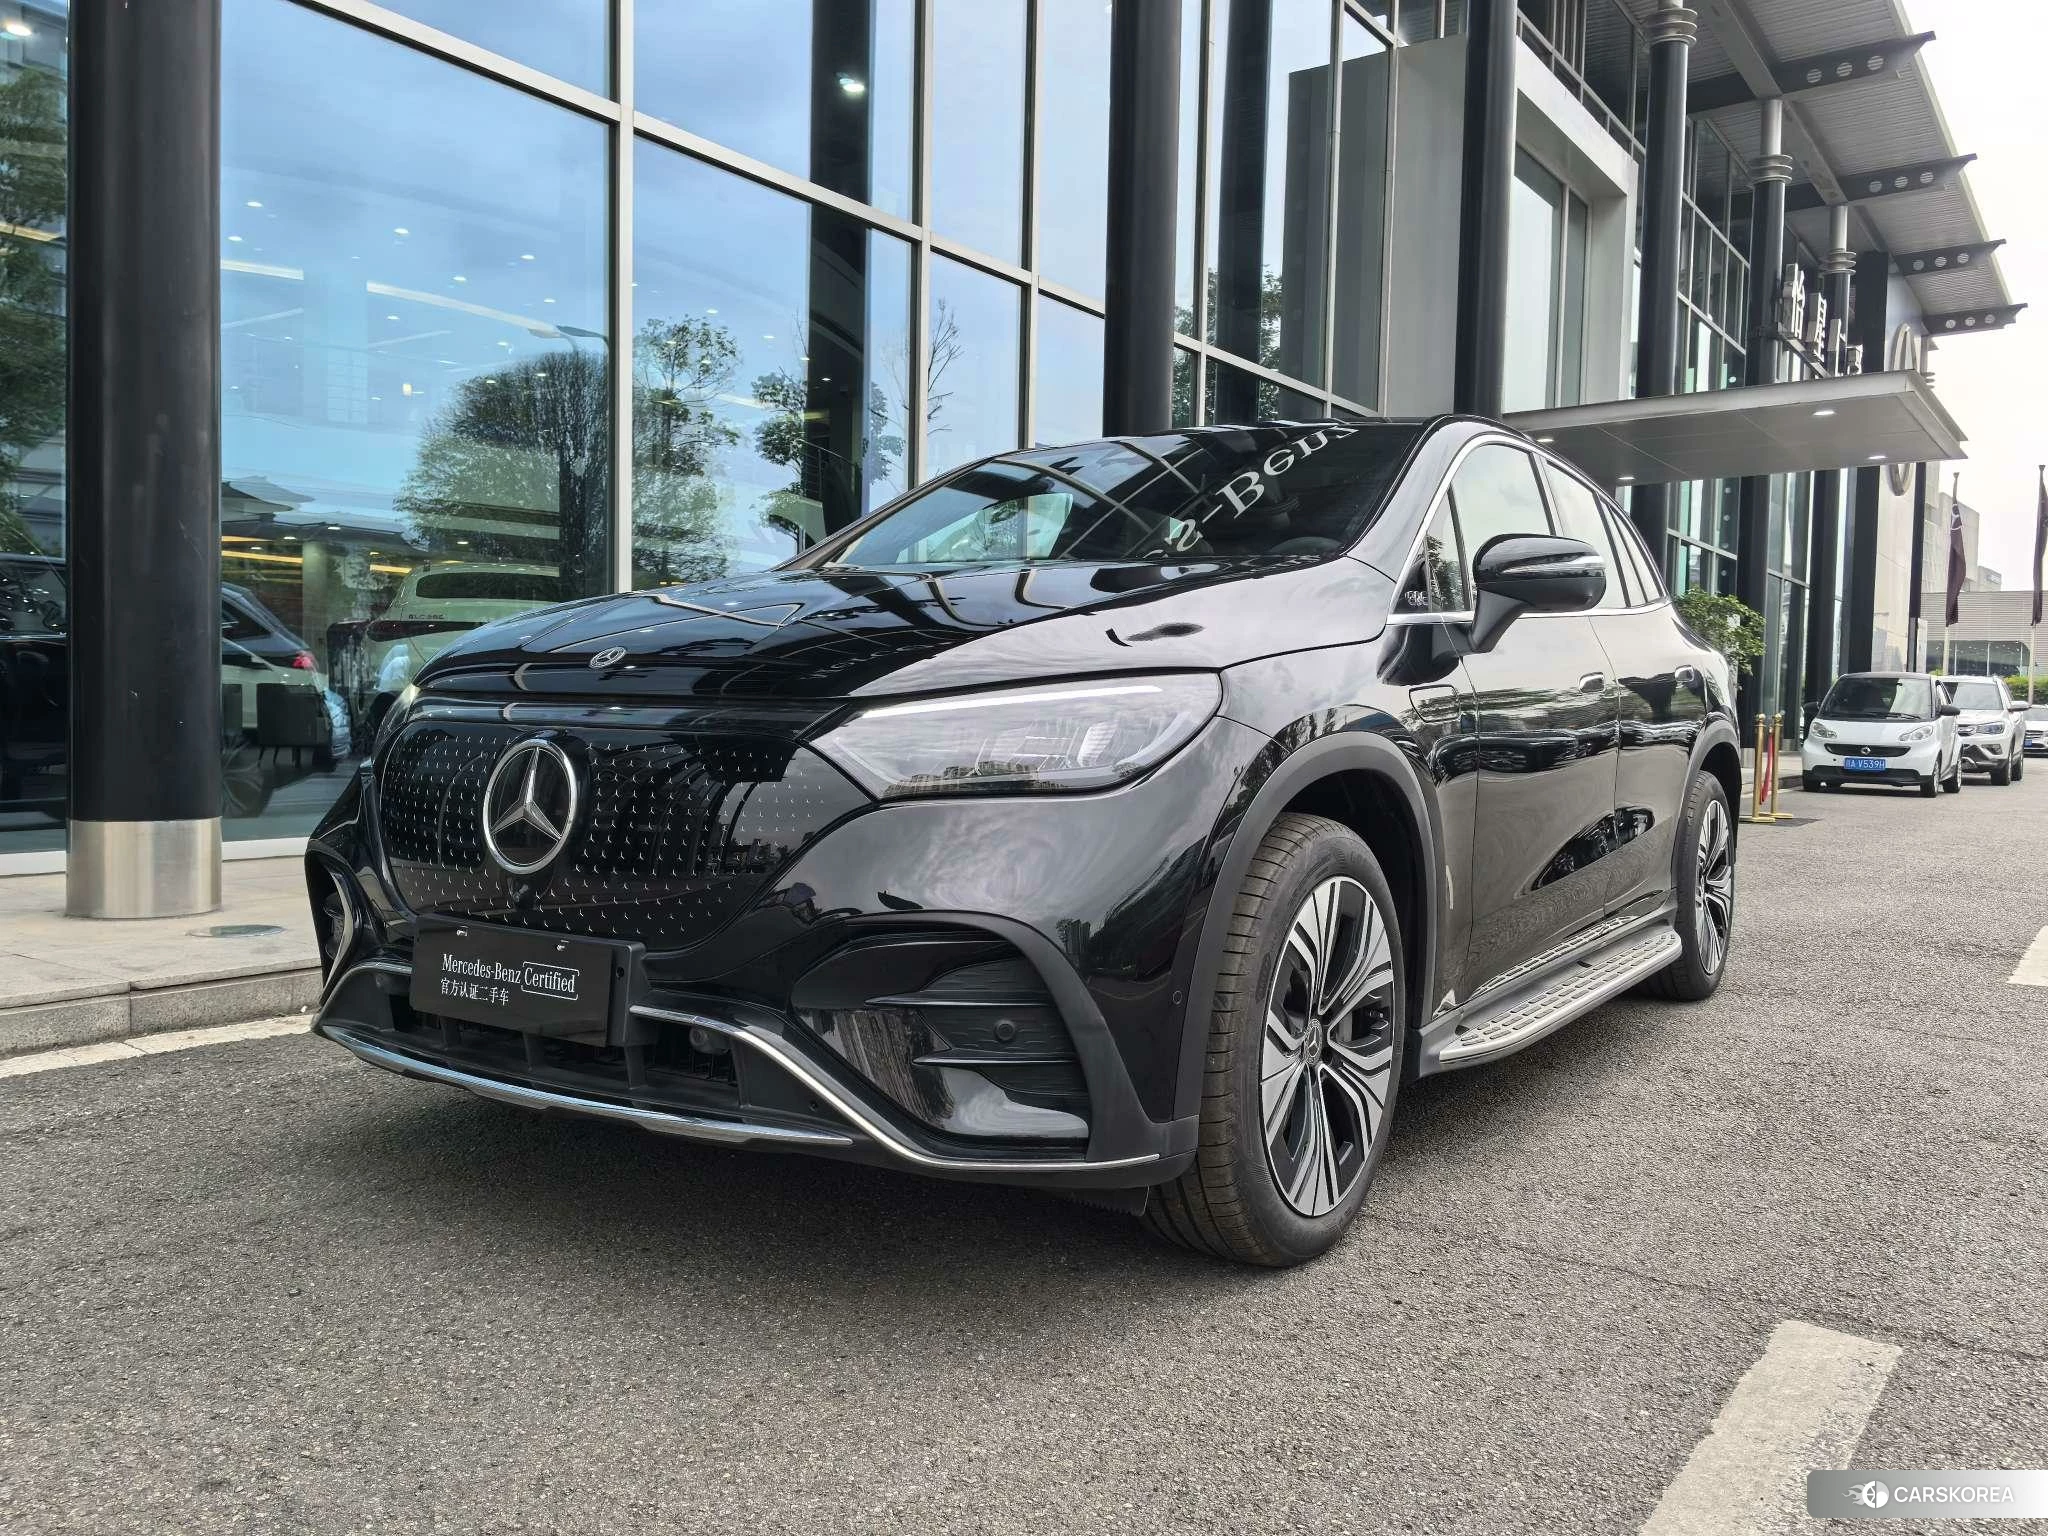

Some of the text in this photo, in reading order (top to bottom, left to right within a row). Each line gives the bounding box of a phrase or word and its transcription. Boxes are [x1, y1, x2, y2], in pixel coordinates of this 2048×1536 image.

[441, 953, 576, 993] Mercedes-Benz Certified
[440, 977, 509, 1006] 官方认证二手车
